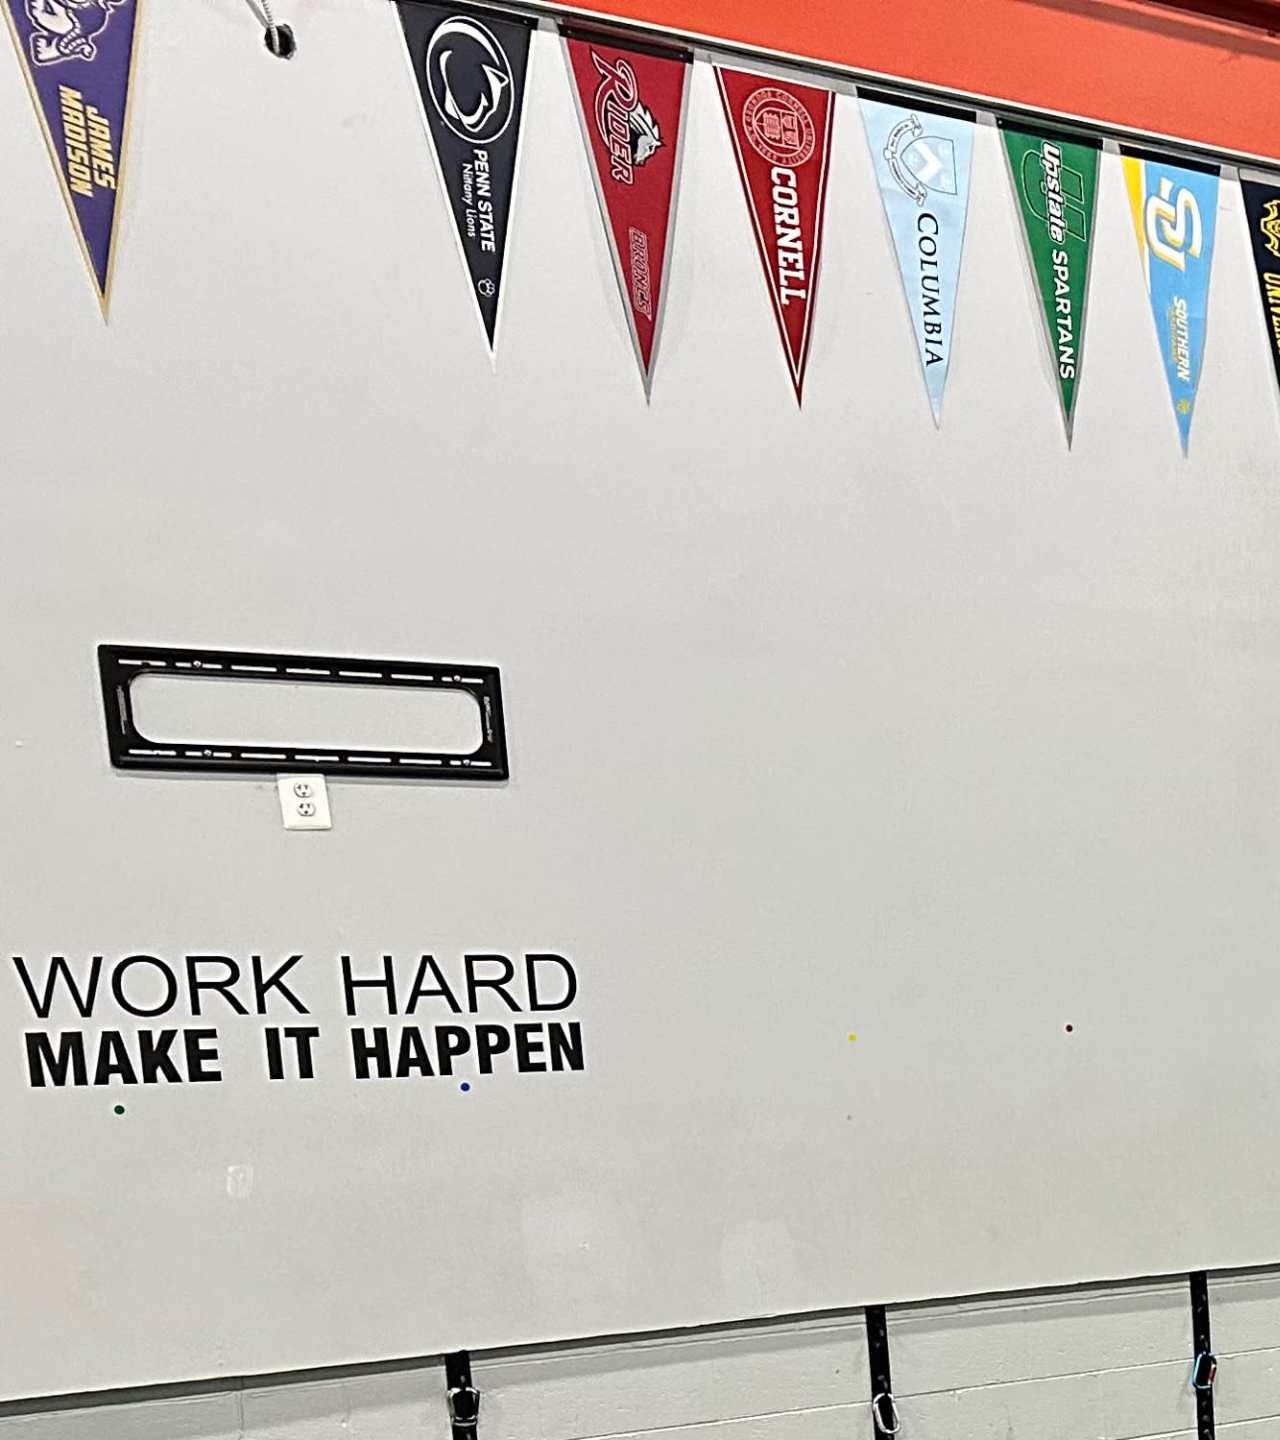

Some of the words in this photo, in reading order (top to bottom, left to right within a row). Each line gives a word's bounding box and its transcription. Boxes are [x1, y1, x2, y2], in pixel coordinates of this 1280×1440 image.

[58, 84, 93, 197] MADISON
[84, 104, 116, 189] JAMES
[591, 52, 638, 185] RIDER
[473, 149, 491, 197] PENN
[466, 208, 477, 237] Lions
[478, 200, 496, 252] STATE
[771, 166, 806, 305] CORNELL
[629, 227, 651, 321] BRONCS
[917, 212, 944, 366] COLUMBIA
[1052, 249, 1074, 379] SPARTANS
[1173, 296, 1190, 381] SOUTHERN
[12, 955, 311, 1018] WORK
[340, 954, 578, 1016] HARD
[24, 1028, 222, 1088] MAKE
[264, 1027, 320, 1079] IT
[350, 1022, 585, 1079] HAPPEN
